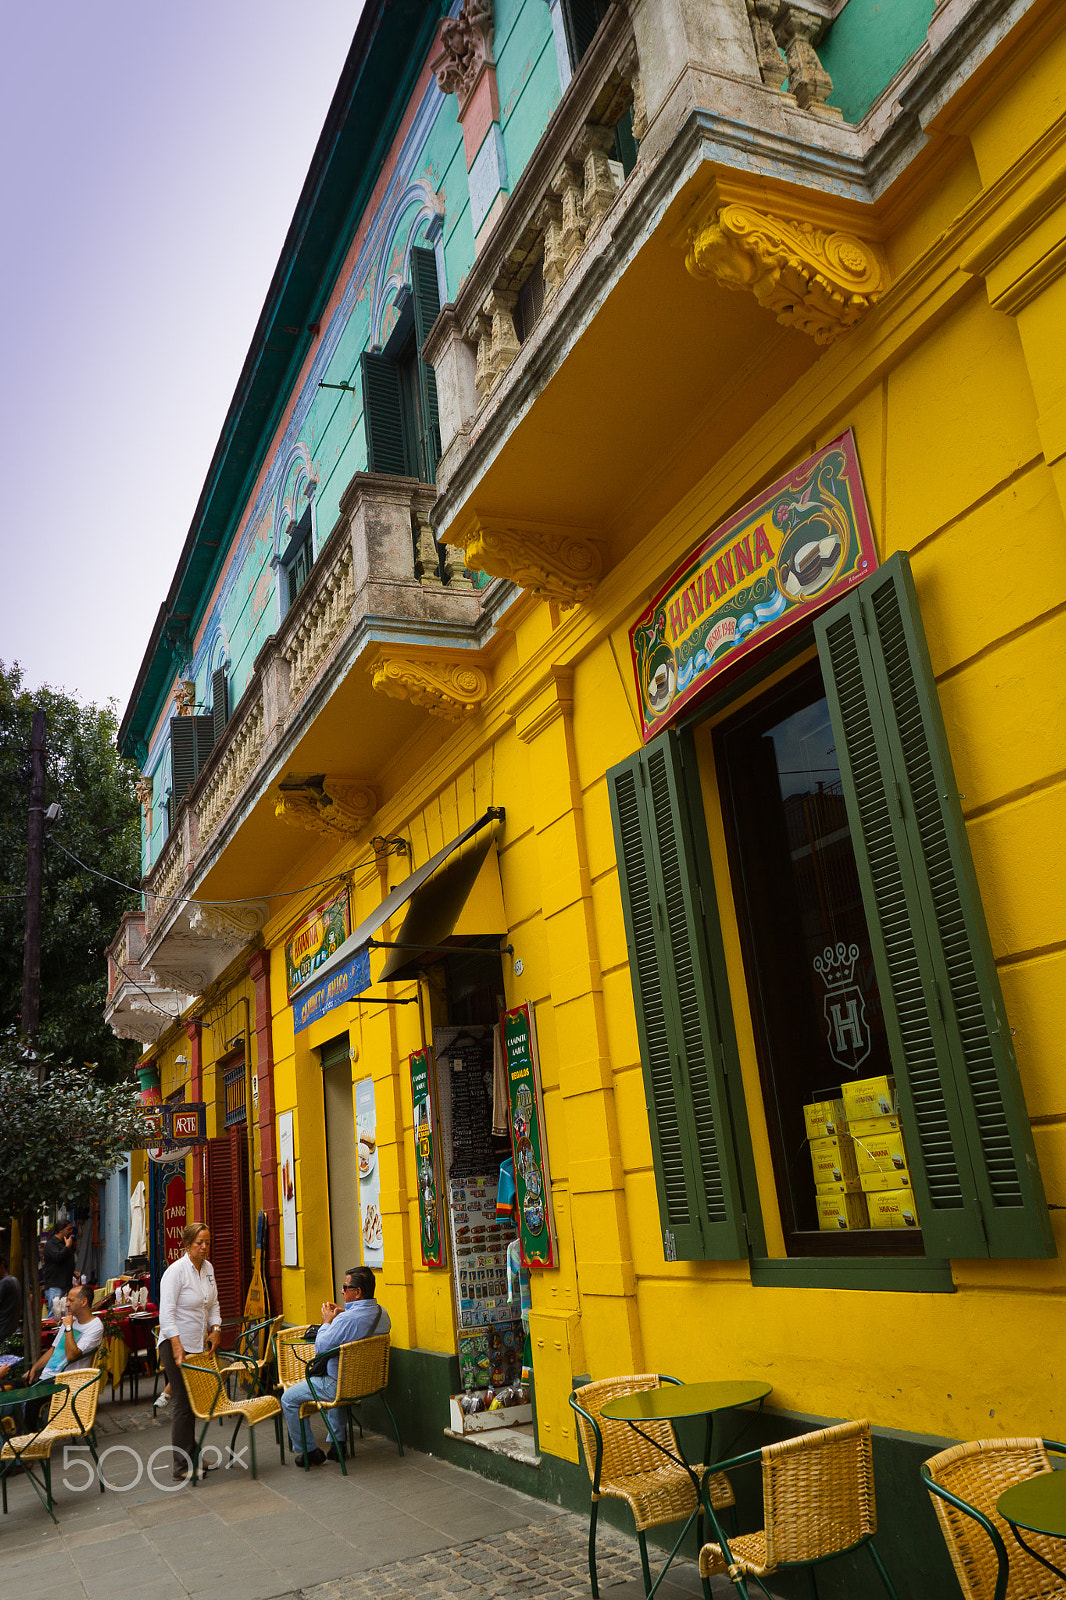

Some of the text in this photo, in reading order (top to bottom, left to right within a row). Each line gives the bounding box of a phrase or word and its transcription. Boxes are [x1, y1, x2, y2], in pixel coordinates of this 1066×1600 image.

[668, 523, 775, 642] HAVANNA
[706, 621, 736, 651] DESDE 1948
[295, 925, 319, 959] HAVANNA
[327, 973, 348, 999] AMIGO
[830, 1000, 864, 1051] H
[510, 1067, 530, 1081] REGALOS
[175, 1116, 196, 1134] ARTE
[165, 1206, 186, 1220] TANG
[166, 1226, 184, 1239] VIN
[168, 1247, 187, 1260] ART
